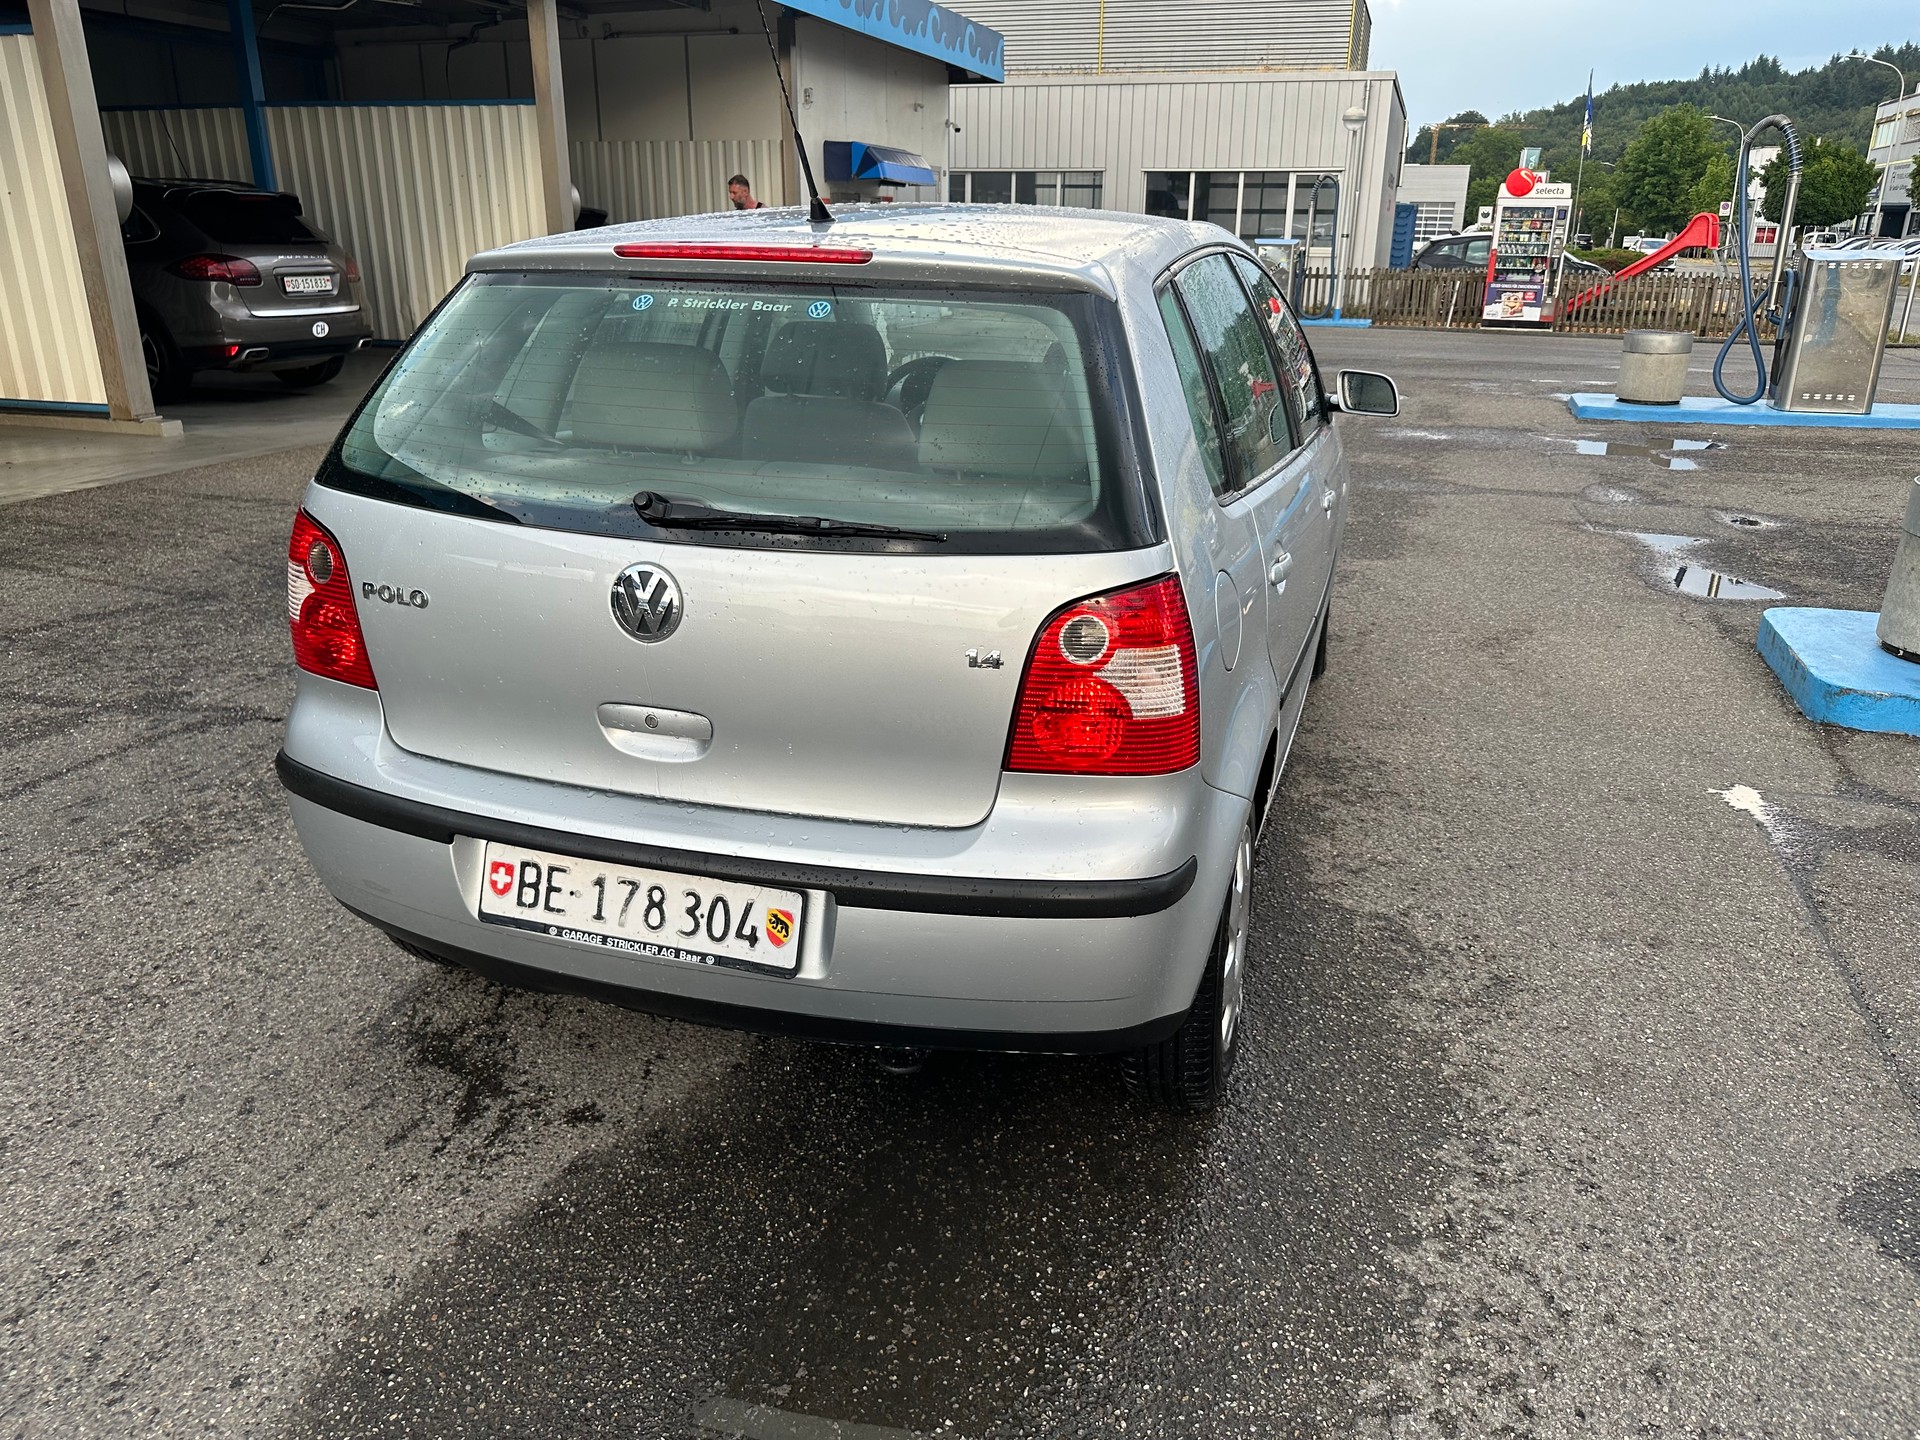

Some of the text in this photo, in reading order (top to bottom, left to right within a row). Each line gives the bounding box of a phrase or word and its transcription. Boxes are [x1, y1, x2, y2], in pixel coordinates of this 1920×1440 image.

[1535, 187, 1565, 195] selecta
[667, 298, 792, 312] P. Strickler Baar
[315, 323, 326, 335] CH
[362, 581, 430, 609] POLO
[562, 929, 603, 945] GARAGE
[606, 938, 659, 955] STRICKLER
[660, 947, 675, 957] AG
[679, 950, 702, 962] Baar
